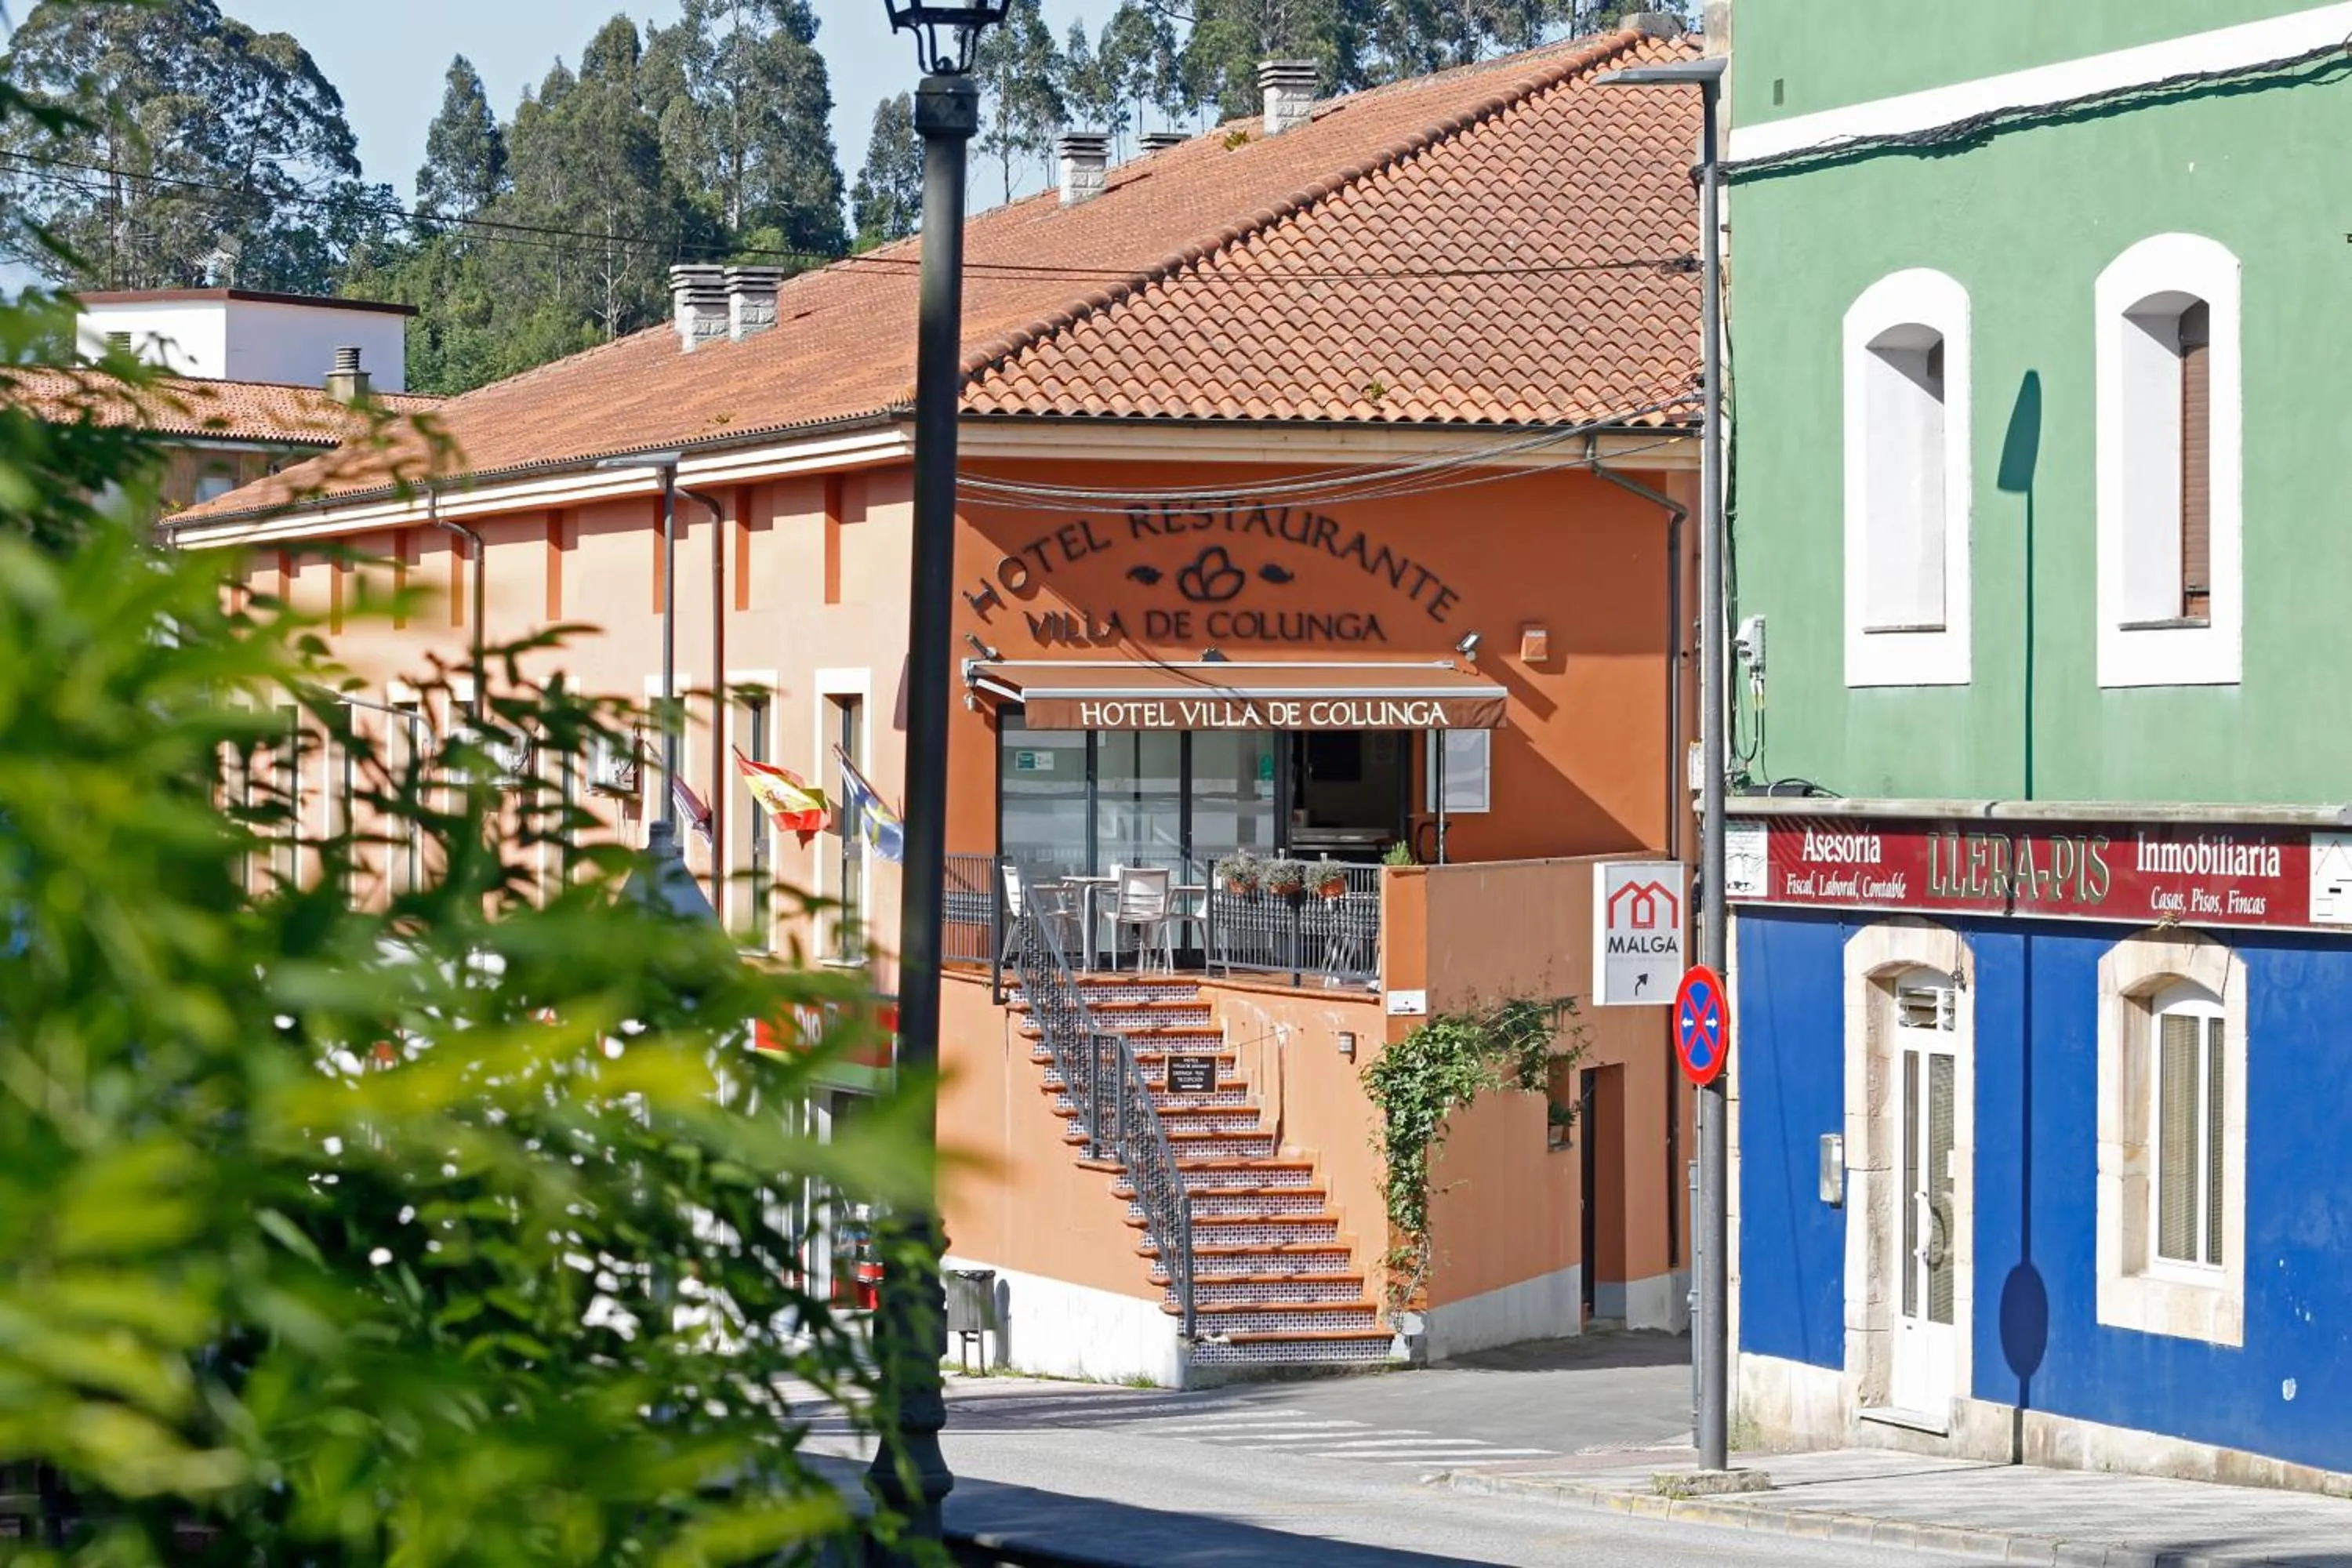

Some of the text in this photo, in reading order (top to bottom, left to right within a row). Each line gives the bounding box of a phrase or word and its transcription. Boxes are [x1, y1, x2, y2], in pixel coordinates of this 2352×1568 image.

[963, 499, 1460, 625] HOTEL RESTAURANTE
[1023, 609, 1387, 644] VILLA DE COLUNGA
[1080, 700, 1450, 728] HOTEL VILLA DE COLUNGA
[1802, 823, 1882, 864] Asesoría
[2136, 830, 2281, 877] Inmobiliaria
[1786, 869, 1907, 900] Fiscal, Laboral, Contable
[1926, 831, 2111, 906] LLERA-PIS
[2151, 885, 2267, 916] Casas, Pisos, Fincas
[1607, 935, 1679, 953] MALGA
